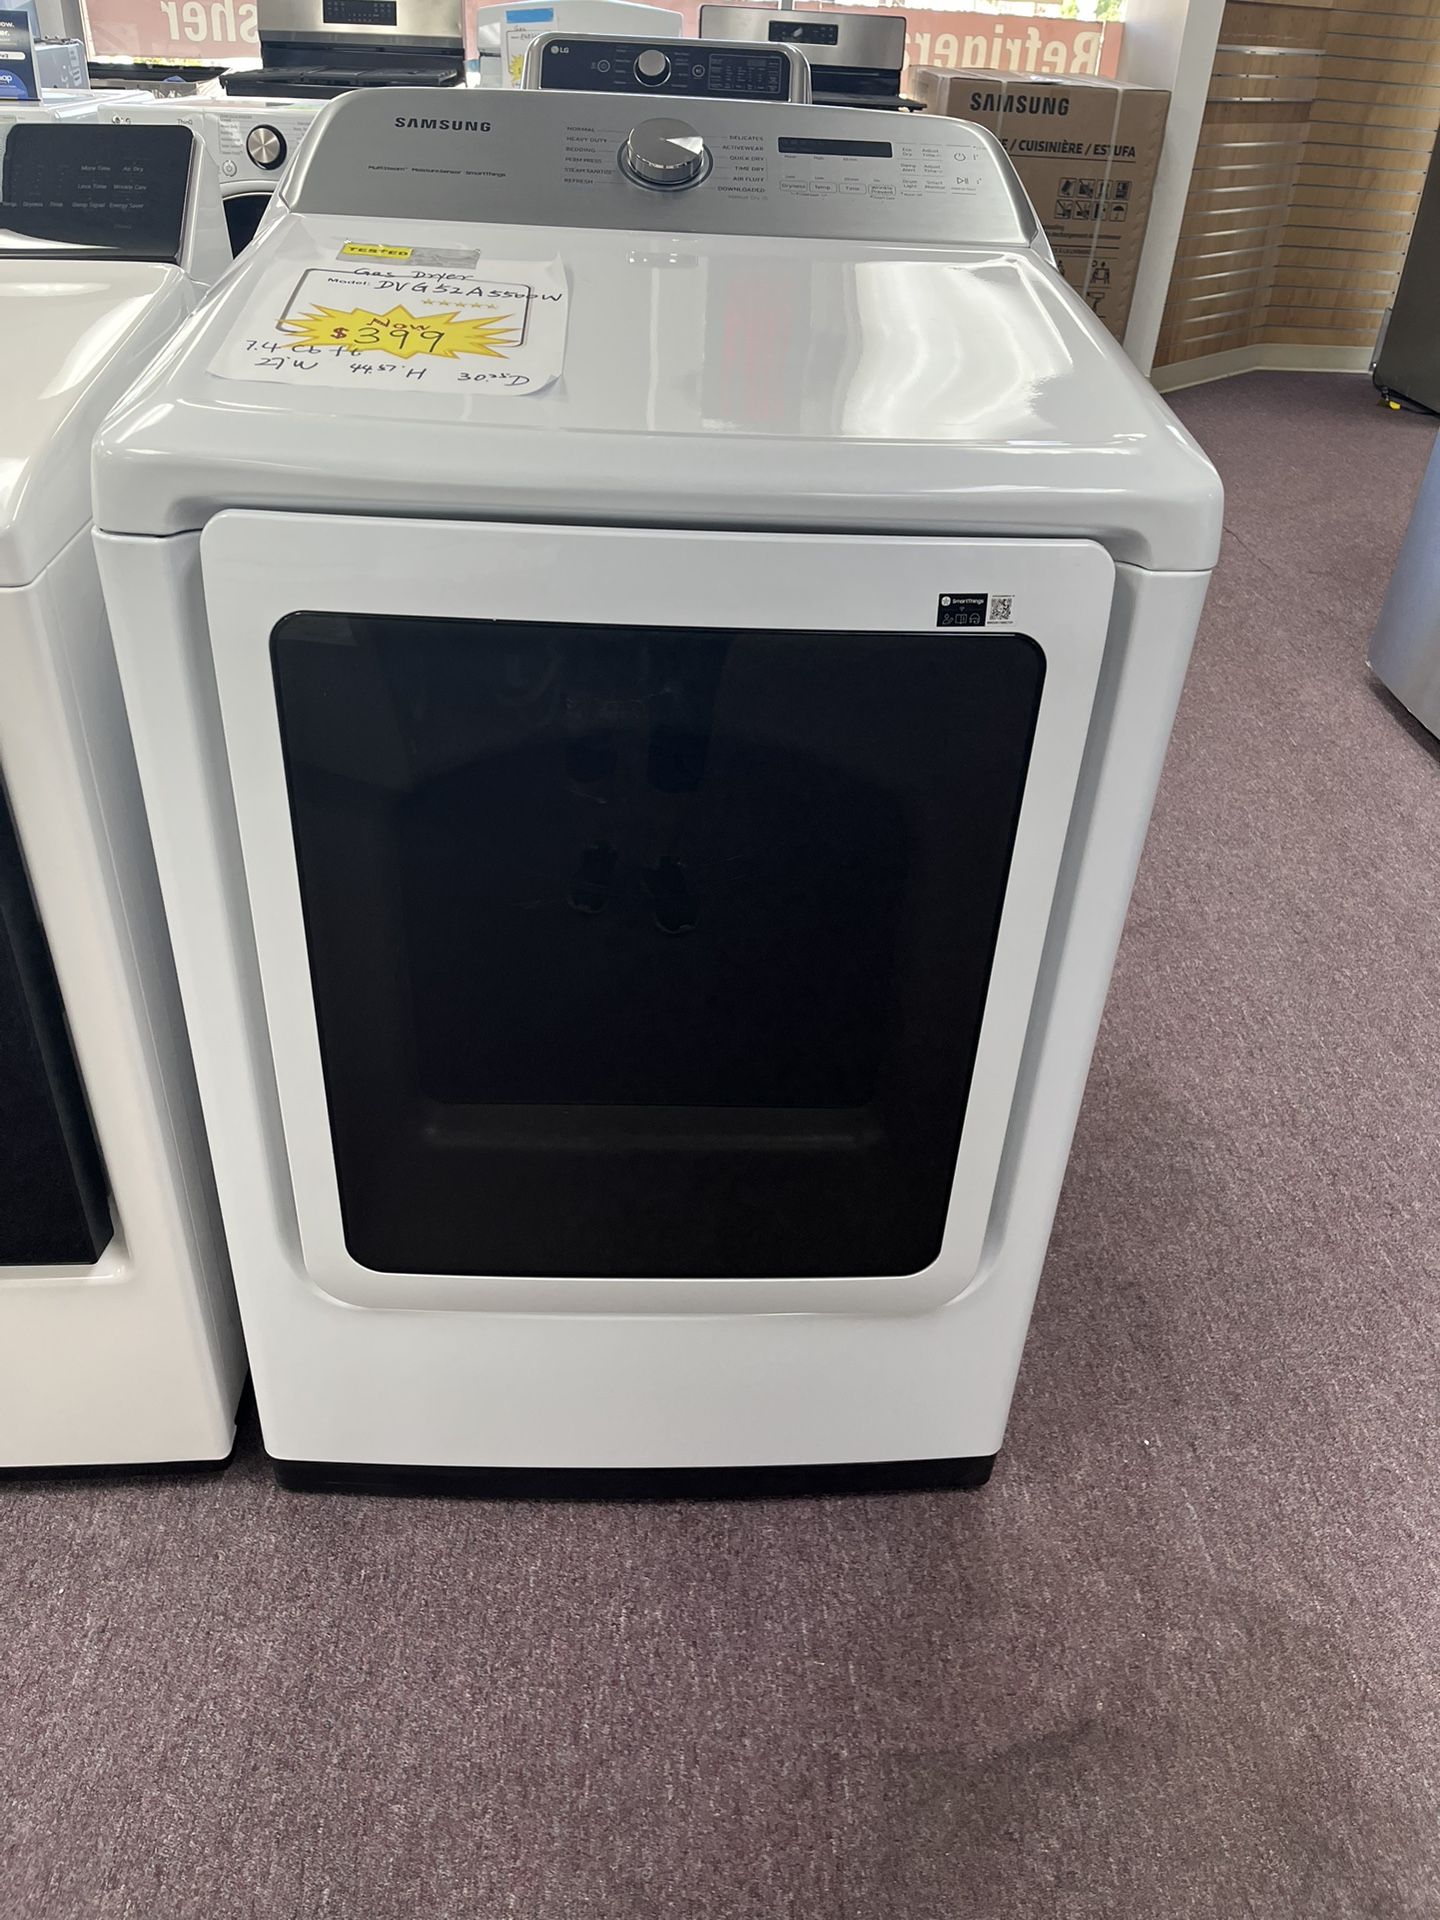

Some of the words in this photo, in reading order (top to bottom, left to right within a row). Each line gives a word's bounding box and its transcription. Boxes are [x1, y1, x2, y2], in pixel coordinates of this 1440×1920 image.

[970, 92, 1070, 116] SAMSUNG
[394, 117, 491, 132] SAMSUNG
[1018, 139, 1083, 155] CUISINIÈRE
[348, 247, 409, 256] TESTED
[353, 268, 395, 278] Gas
[411, 270, 474, 283] Dryer
